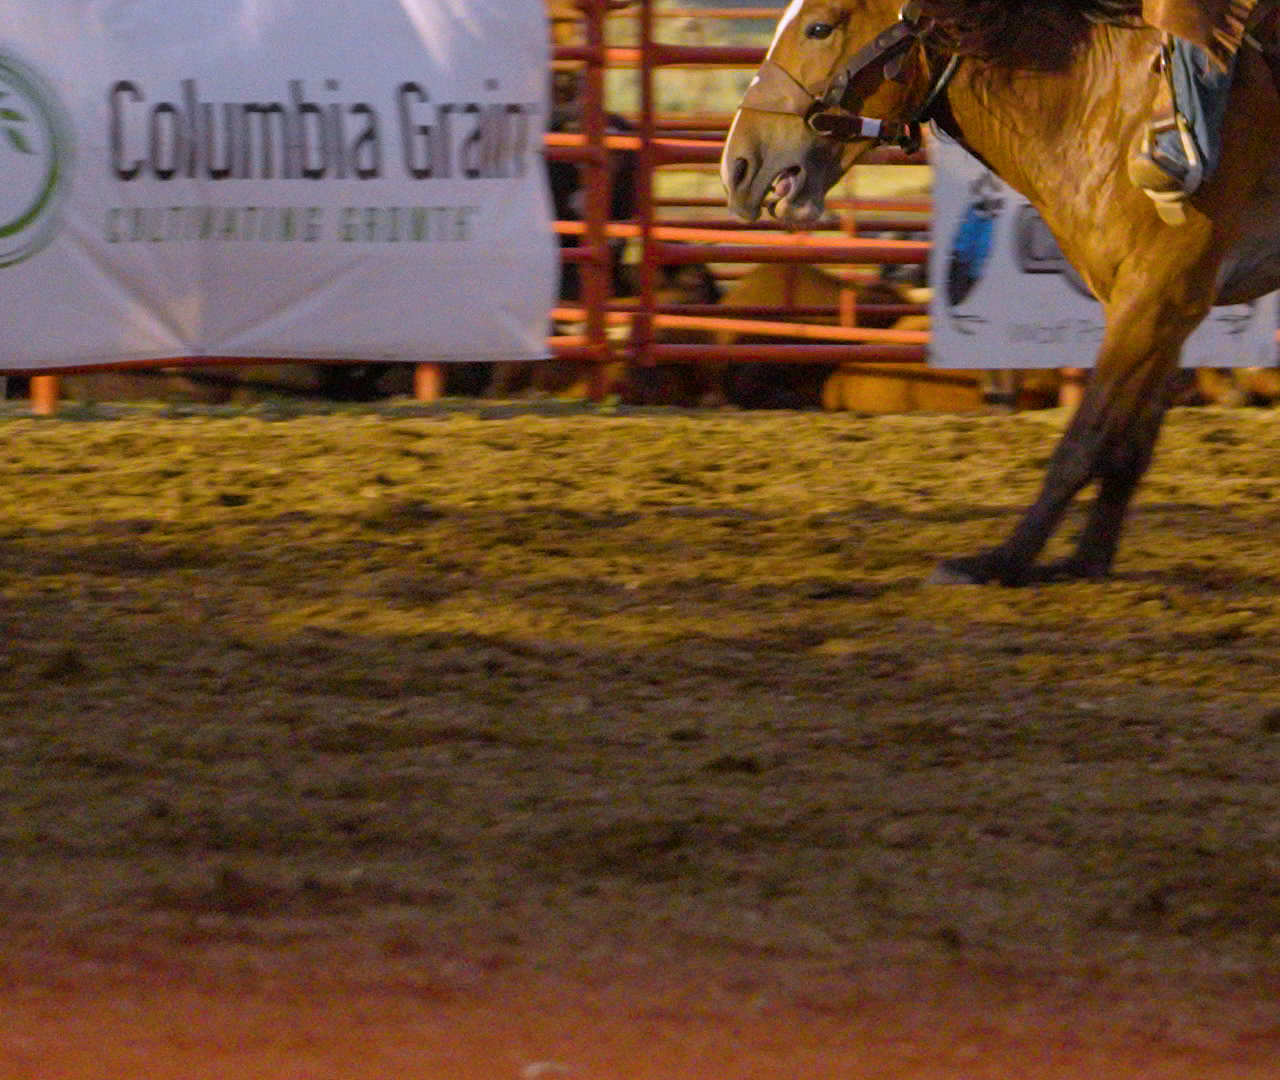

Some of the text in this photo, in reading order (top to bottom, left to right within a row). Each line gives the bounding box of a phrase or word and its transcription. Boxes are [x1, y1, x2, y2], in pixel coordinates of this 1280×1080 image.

[108, 78, 532, 181] Columbia Grain
[104, 206, 322, 244] CULTIVATING
